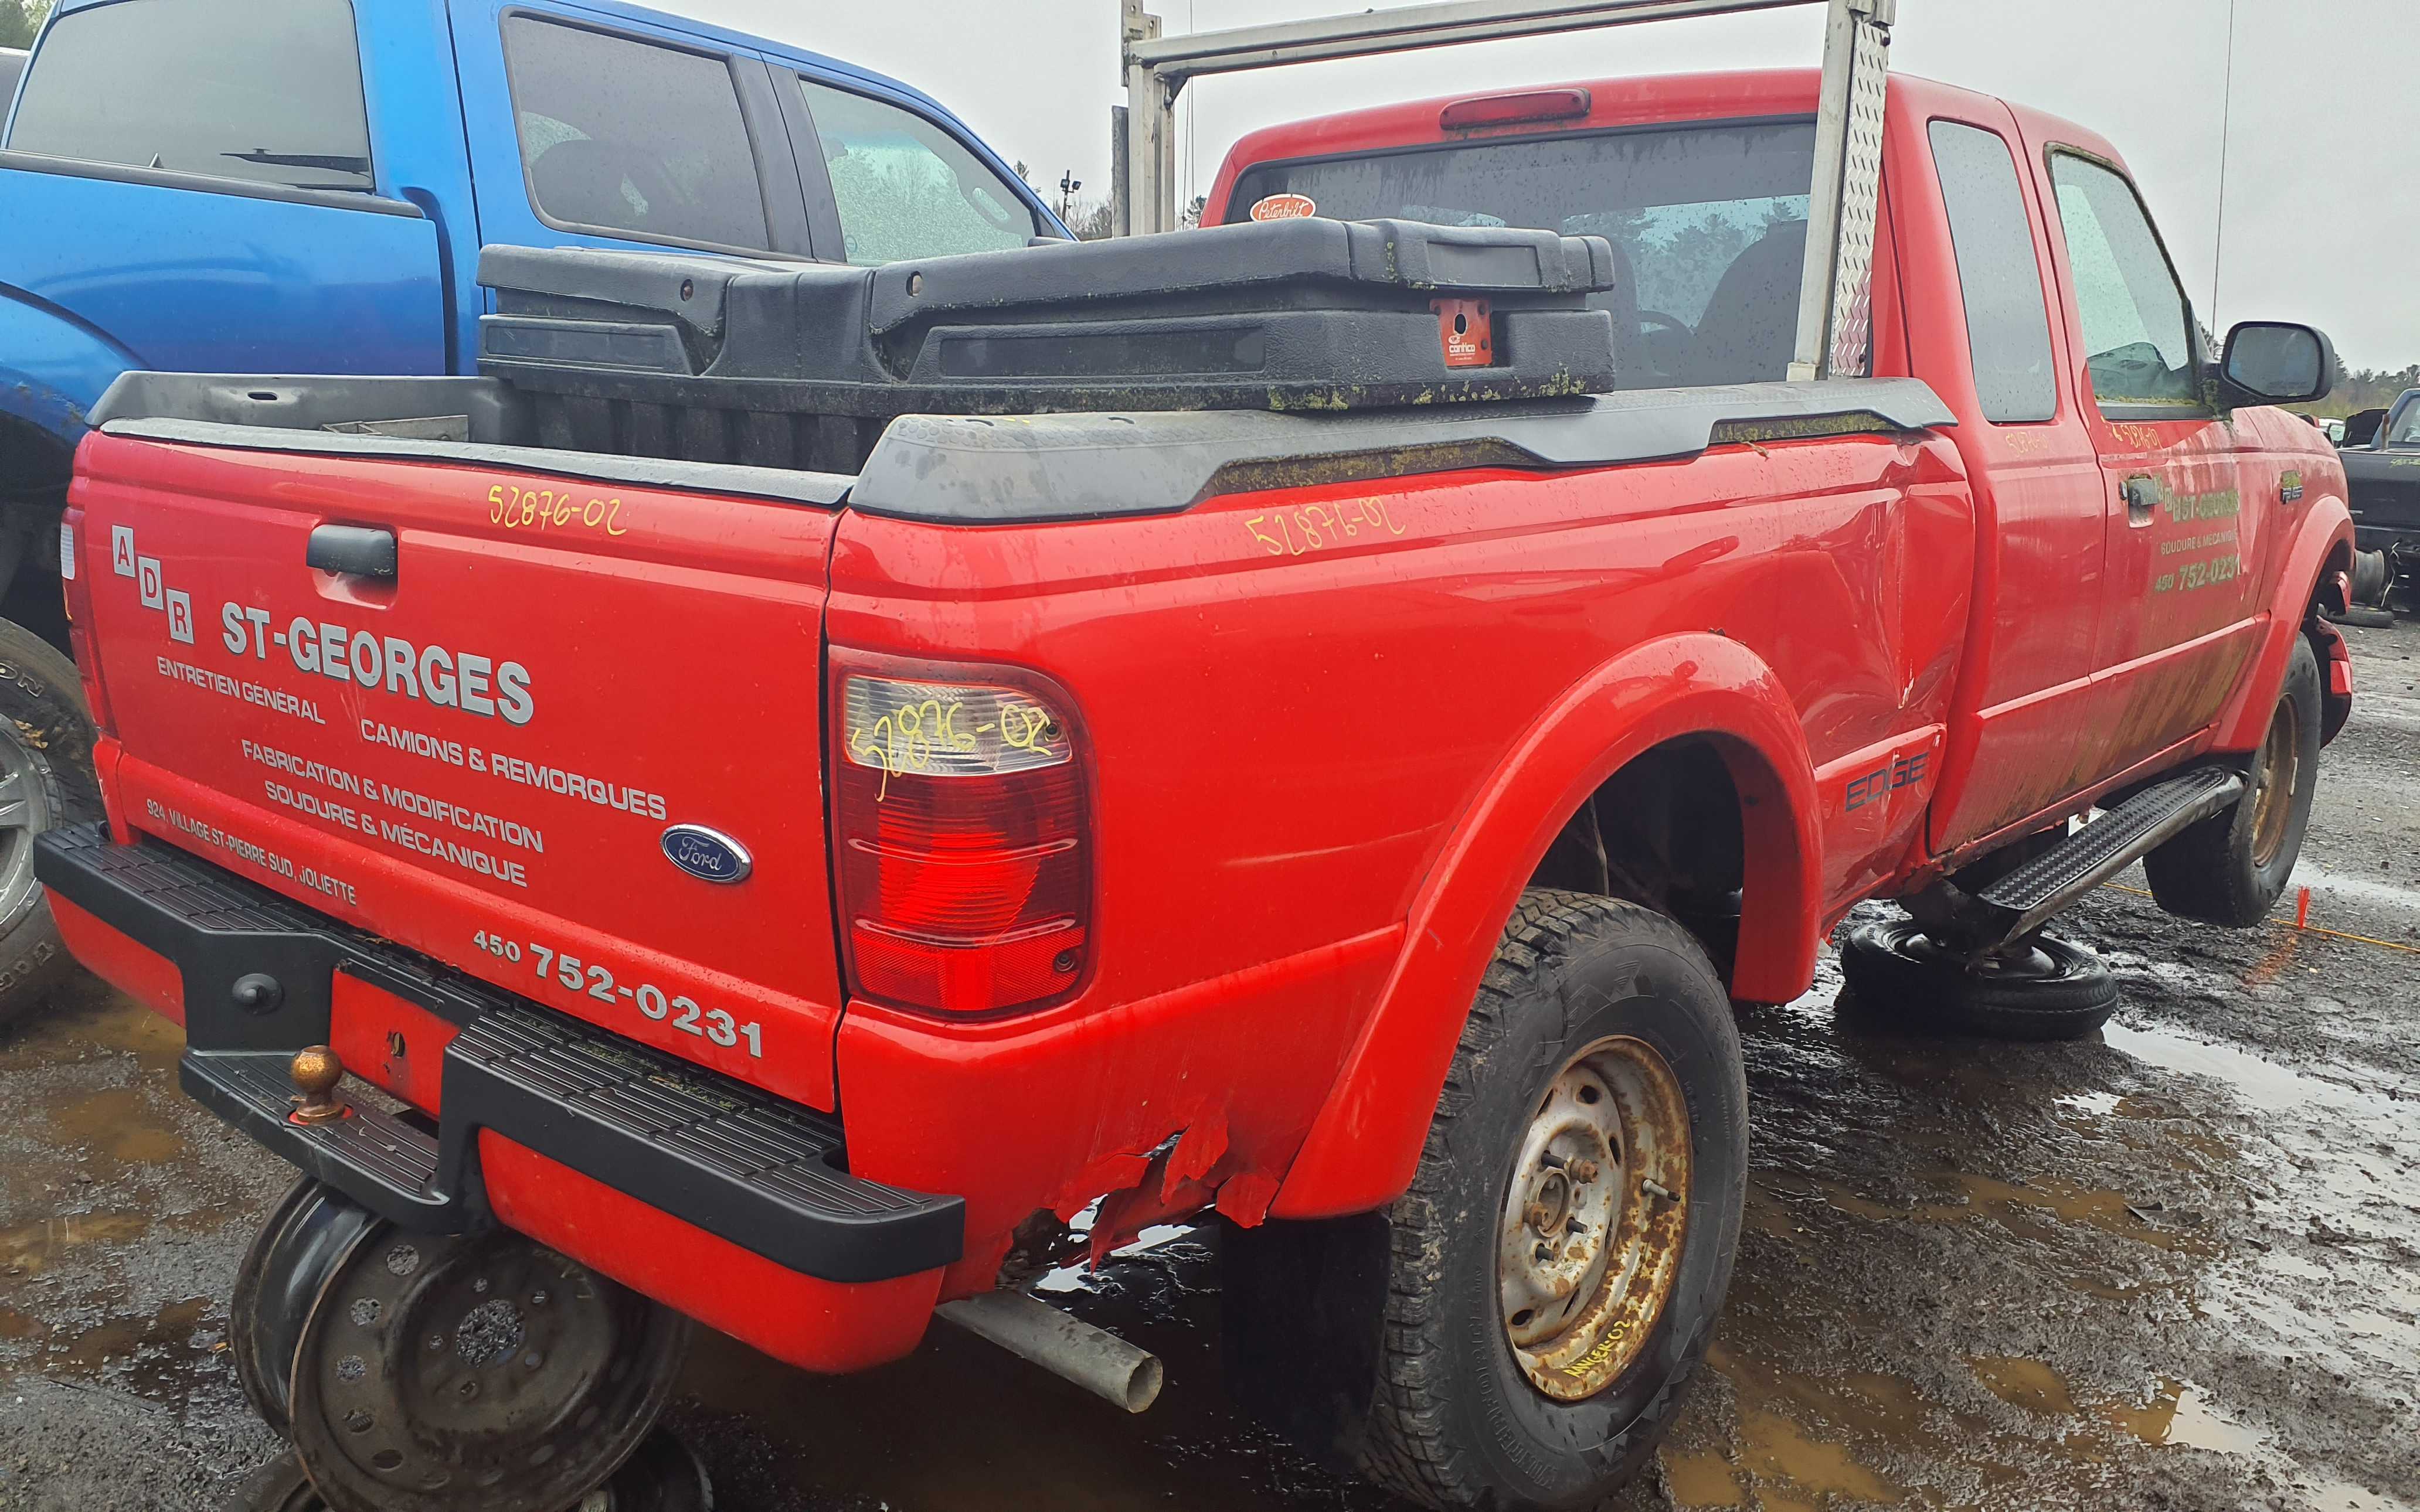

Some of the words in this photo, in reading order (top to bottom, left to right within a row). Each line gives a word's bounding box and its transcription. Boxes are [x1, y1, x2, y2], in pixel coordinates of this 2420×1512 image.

[1258, 201, 1309, 220] Peterbilt
[488, 485, 627, 536] 52876-02
[1245, 497, 1406, 556] 52876-02
[157, 656, 240, 699] ENTRETIEN
[242, 680, 326, 725] GÉNÉRAL
[222, 601, 535, 726] ST-GEORGES
[241, 738, 361, 796] FABRICATION
[363, 778, 379, 801] &
[382, 783, 544, 853] MODIFICATION
[361, 718, 464, 767] CAMIONS
[469, 747, 488, 773] &
[491, 752, 667, 821] REMORQUES
[1845, 751, 1929, 812] EDGE
[169, 809, 210, 842] VILLAGE
[211, 829, 267, 868] ST-PIERRE
[299, 865, 357, 905] JOLIETTE
[264, 779, 358, 830] SOUDURE
[361, 813, 378, 836] &
[380, 819, 528, 888] MÉCANIQUE
[679, 836, 723, 871] Ford
[473, 929, 521, 963] 450
[529, 942, 762, 1058] 752-0231
